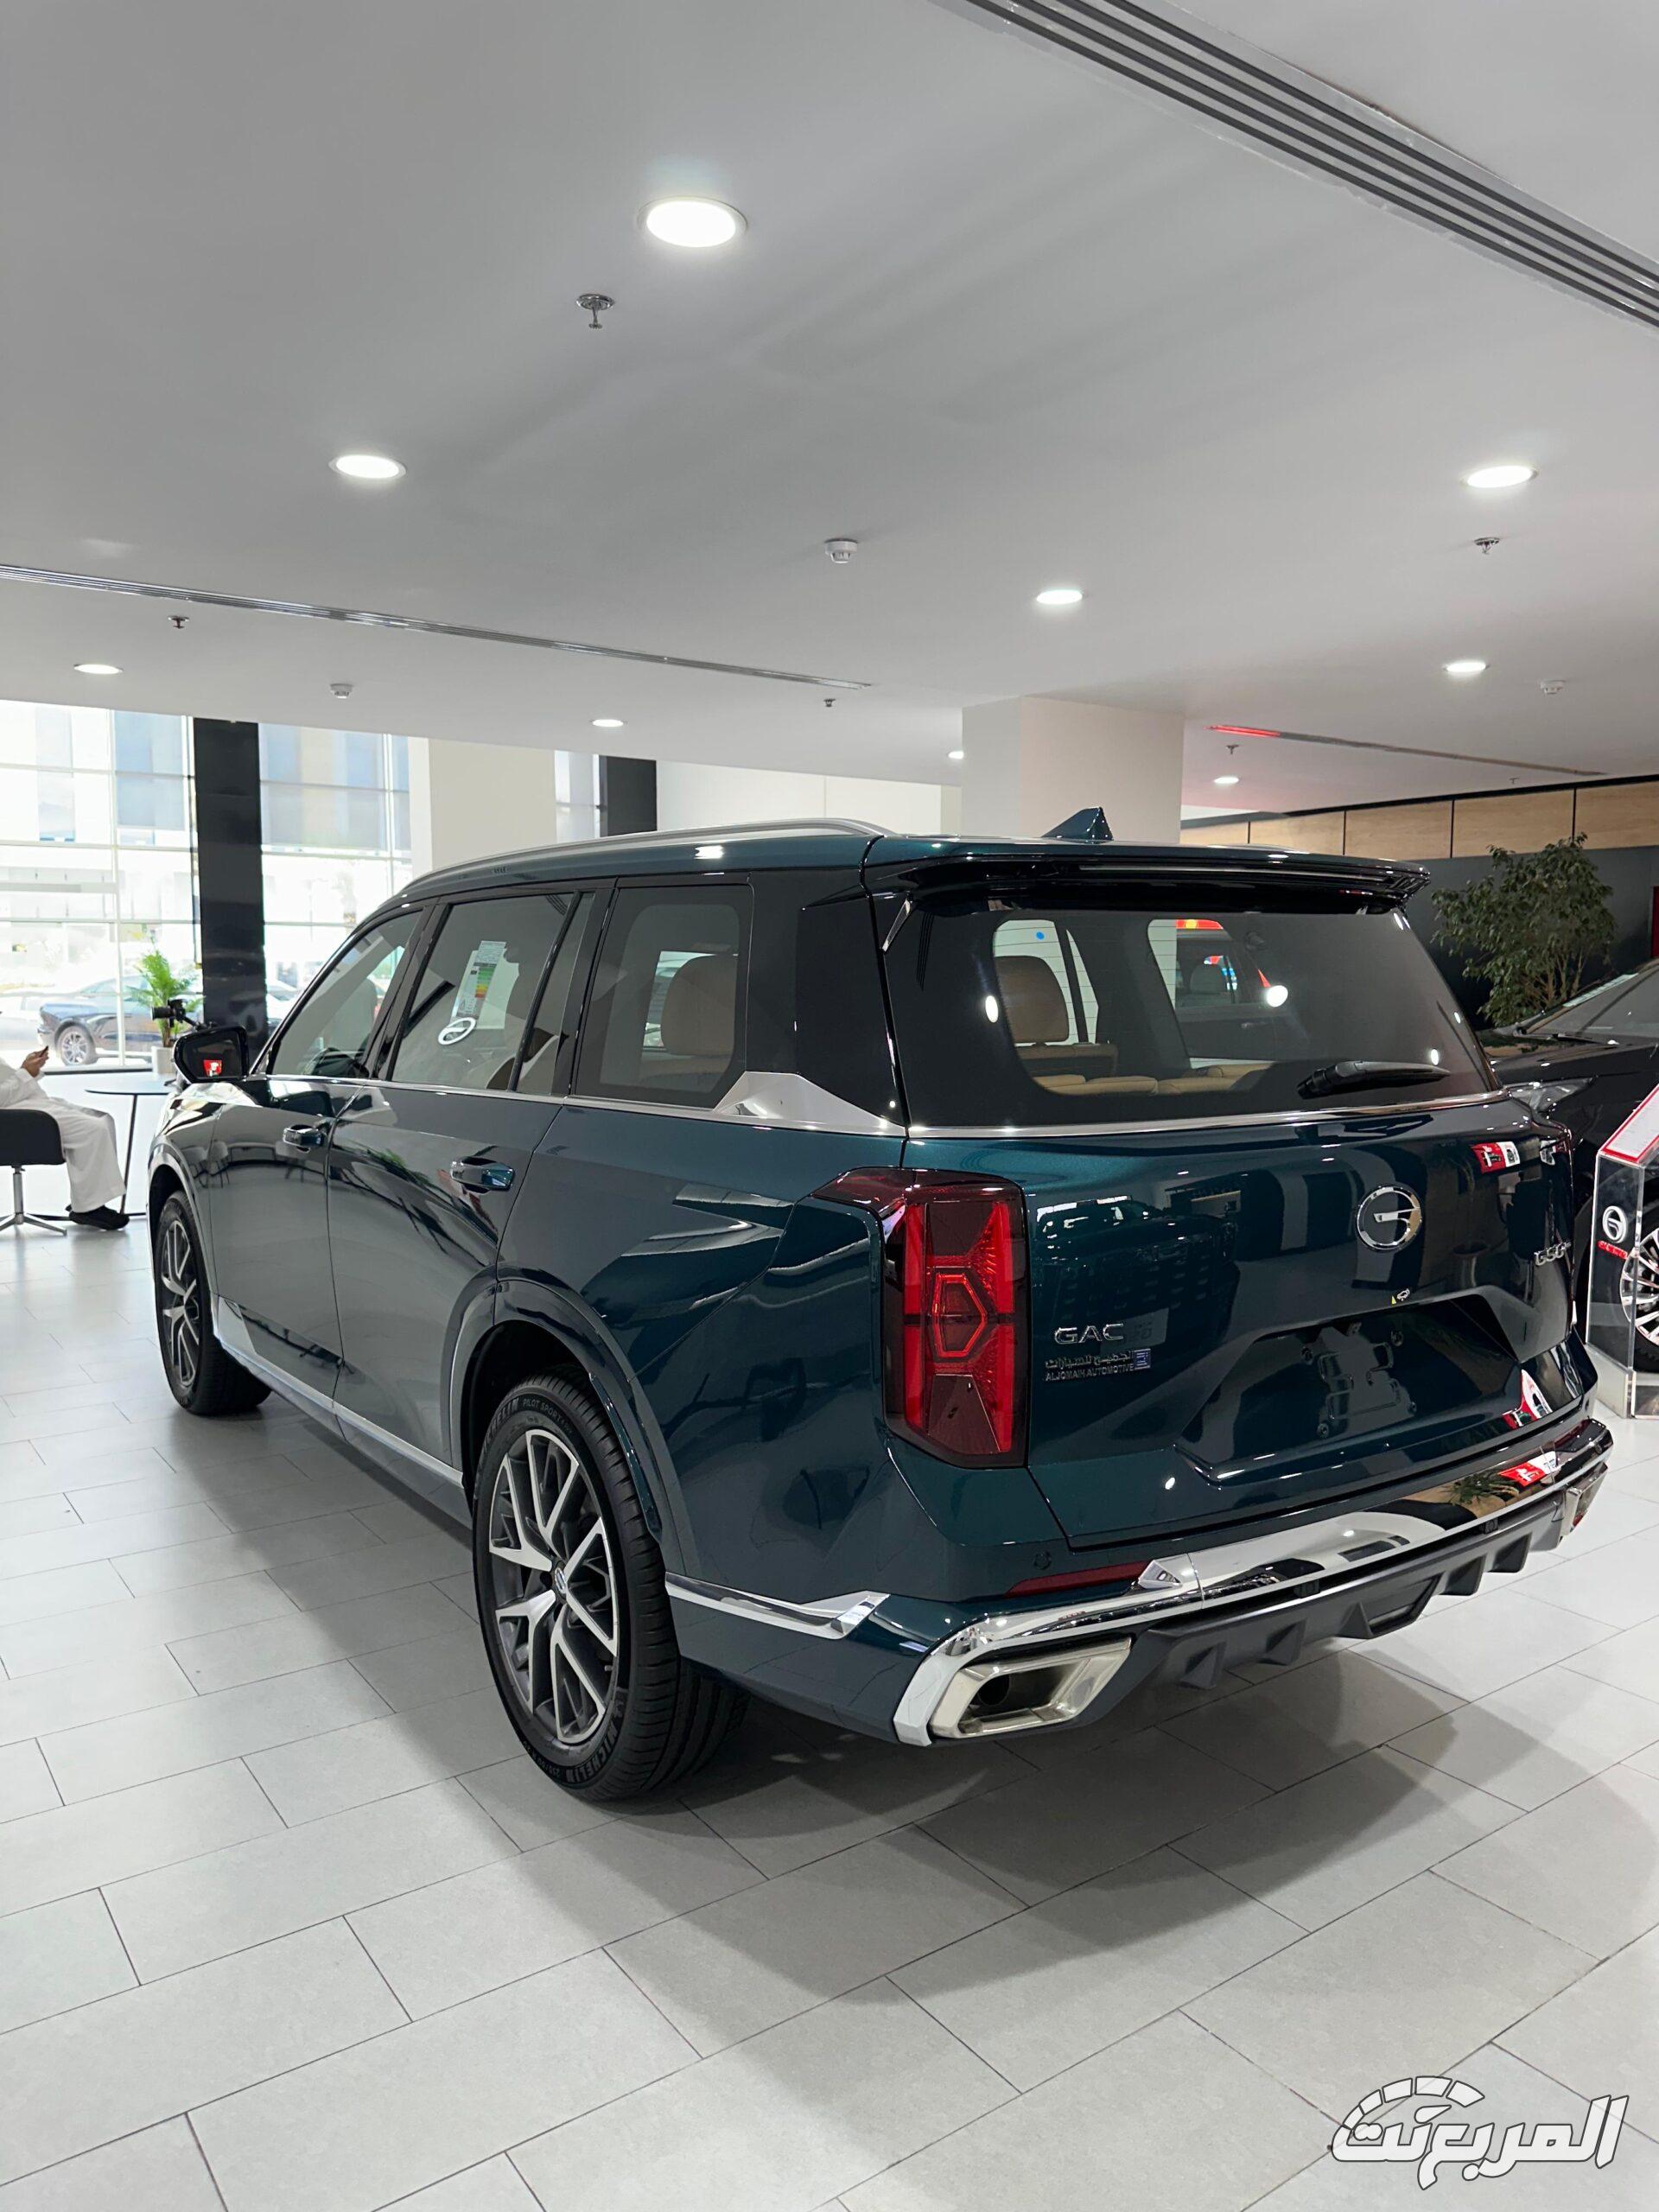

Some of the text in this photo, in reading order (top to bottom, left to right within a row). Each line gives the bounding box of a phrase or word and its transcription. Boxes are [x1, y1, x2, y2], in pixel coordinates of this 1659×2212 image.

[1054, 1323, 1124, 1344] GAC
[1086, 1364, 1135, 1377] AUTOMOTIVE
[522, 1399, 540, 1408] PILOT
[541, 1402, 561, 1421] SPORT
[565, 1720, 618, 1783] MICHELIN
